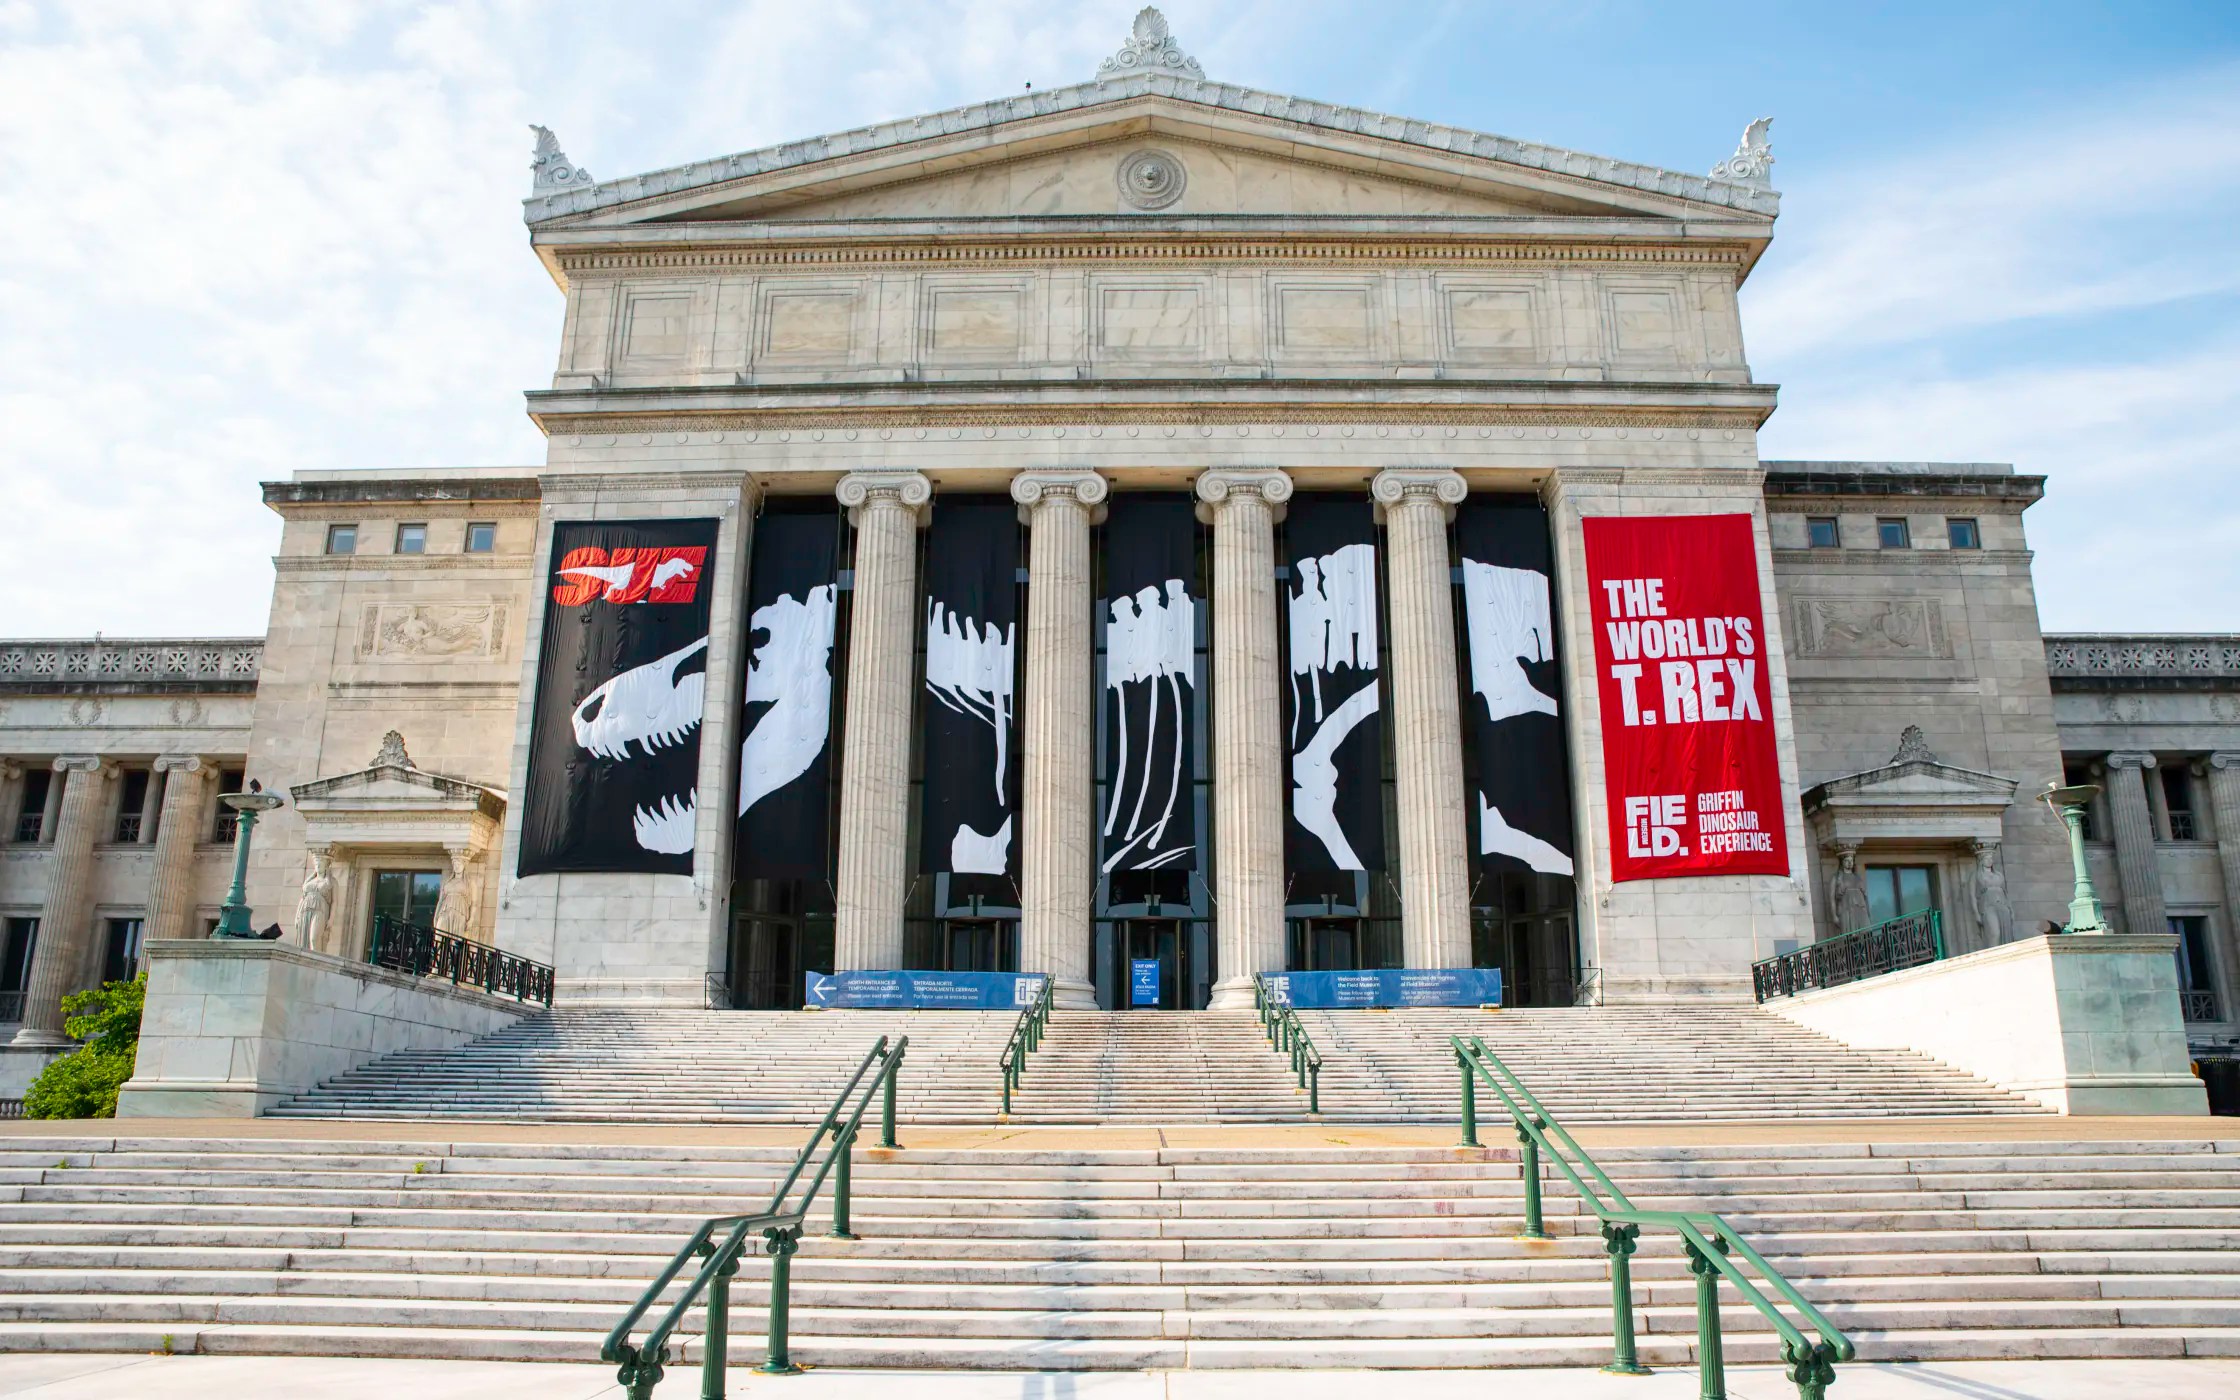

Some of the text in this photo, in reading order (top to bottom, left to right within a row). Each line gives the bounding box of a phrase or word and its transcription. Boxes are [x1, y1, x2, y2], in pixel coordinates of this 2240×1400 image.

[553, 546, 707, 606] SUE
[1602, 578, 1667, 618] THE
[1606, 616, 1755, 661] WORLD'S
[1697, 790, 1744, 812] GRIFFIN
[1640, 818, 1649, 845] MUSEUM
[1699, 811, 1759, 833] DINOSAUR
[1700, 832, 1773, 854] EXPERIENCE
